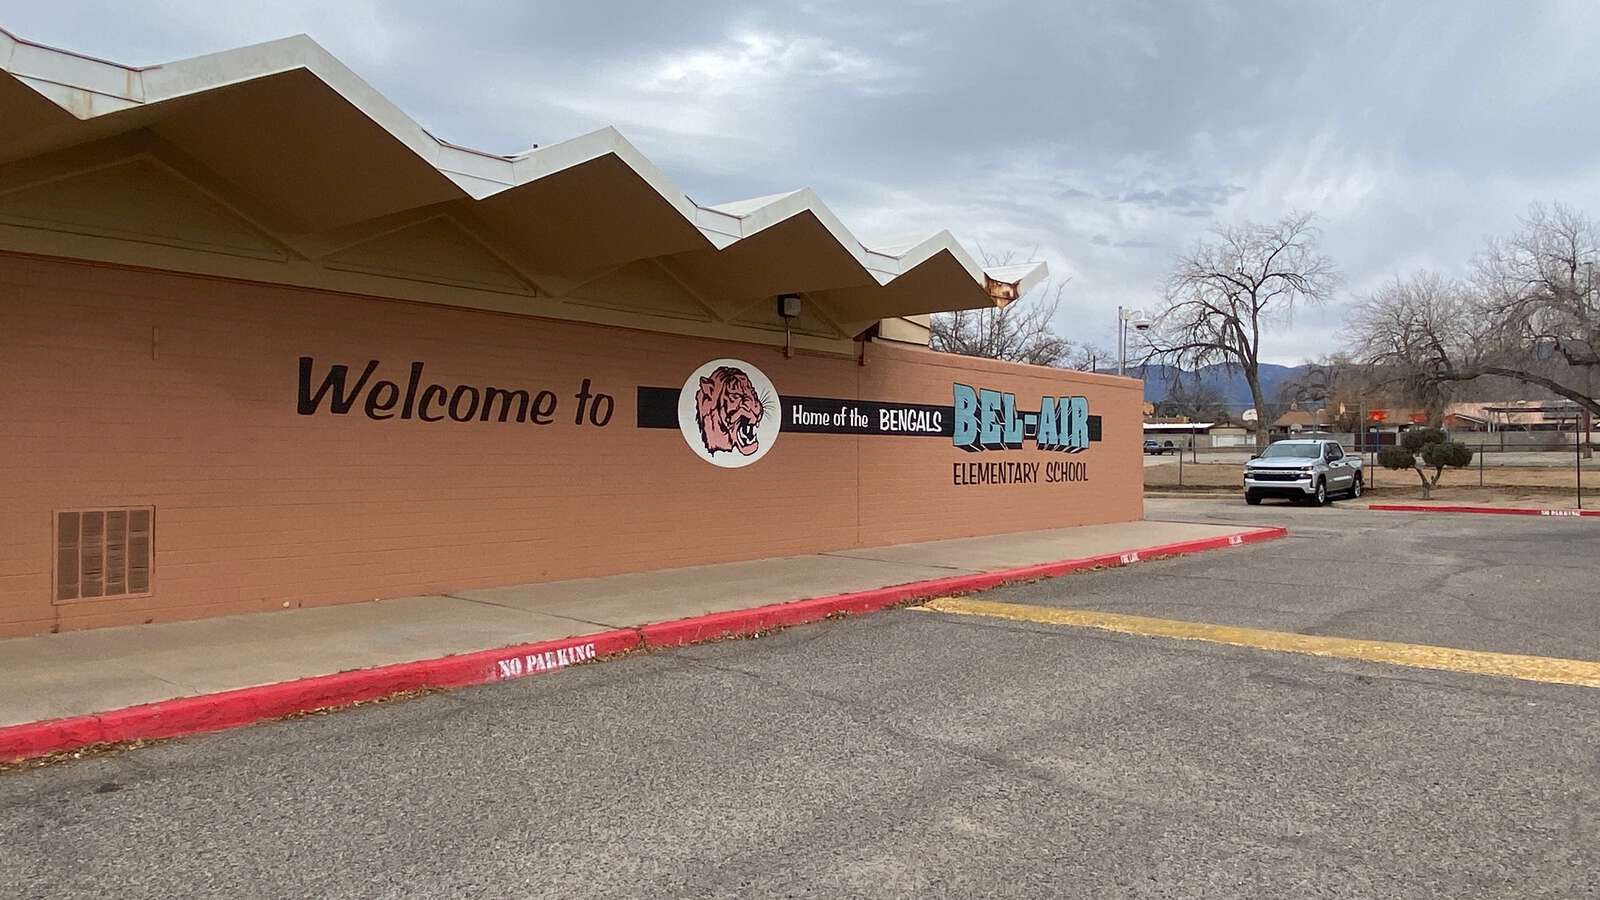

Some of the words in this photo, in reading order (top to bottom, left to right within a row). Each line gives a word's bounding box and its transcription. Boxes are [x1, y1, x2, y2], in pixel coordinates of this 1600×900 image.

[297, 356, 558, 426] Welcome
[574, 378, 615, 427] to
[792, 405, 830, 426] Home
[833, 406, 847, 427] of
[849, 407, 869, 428] the
[879, 408, 943, 433] BENGALS
[952, 382, 1091, 453] BEL-AIR
[953, 461, 1040, 485] ELEMENTARY
[1045, 461, 1089, 483] SCHOOL
[498, 657, 522, 678] NO
[526, 643, 596, 673] PARKING
